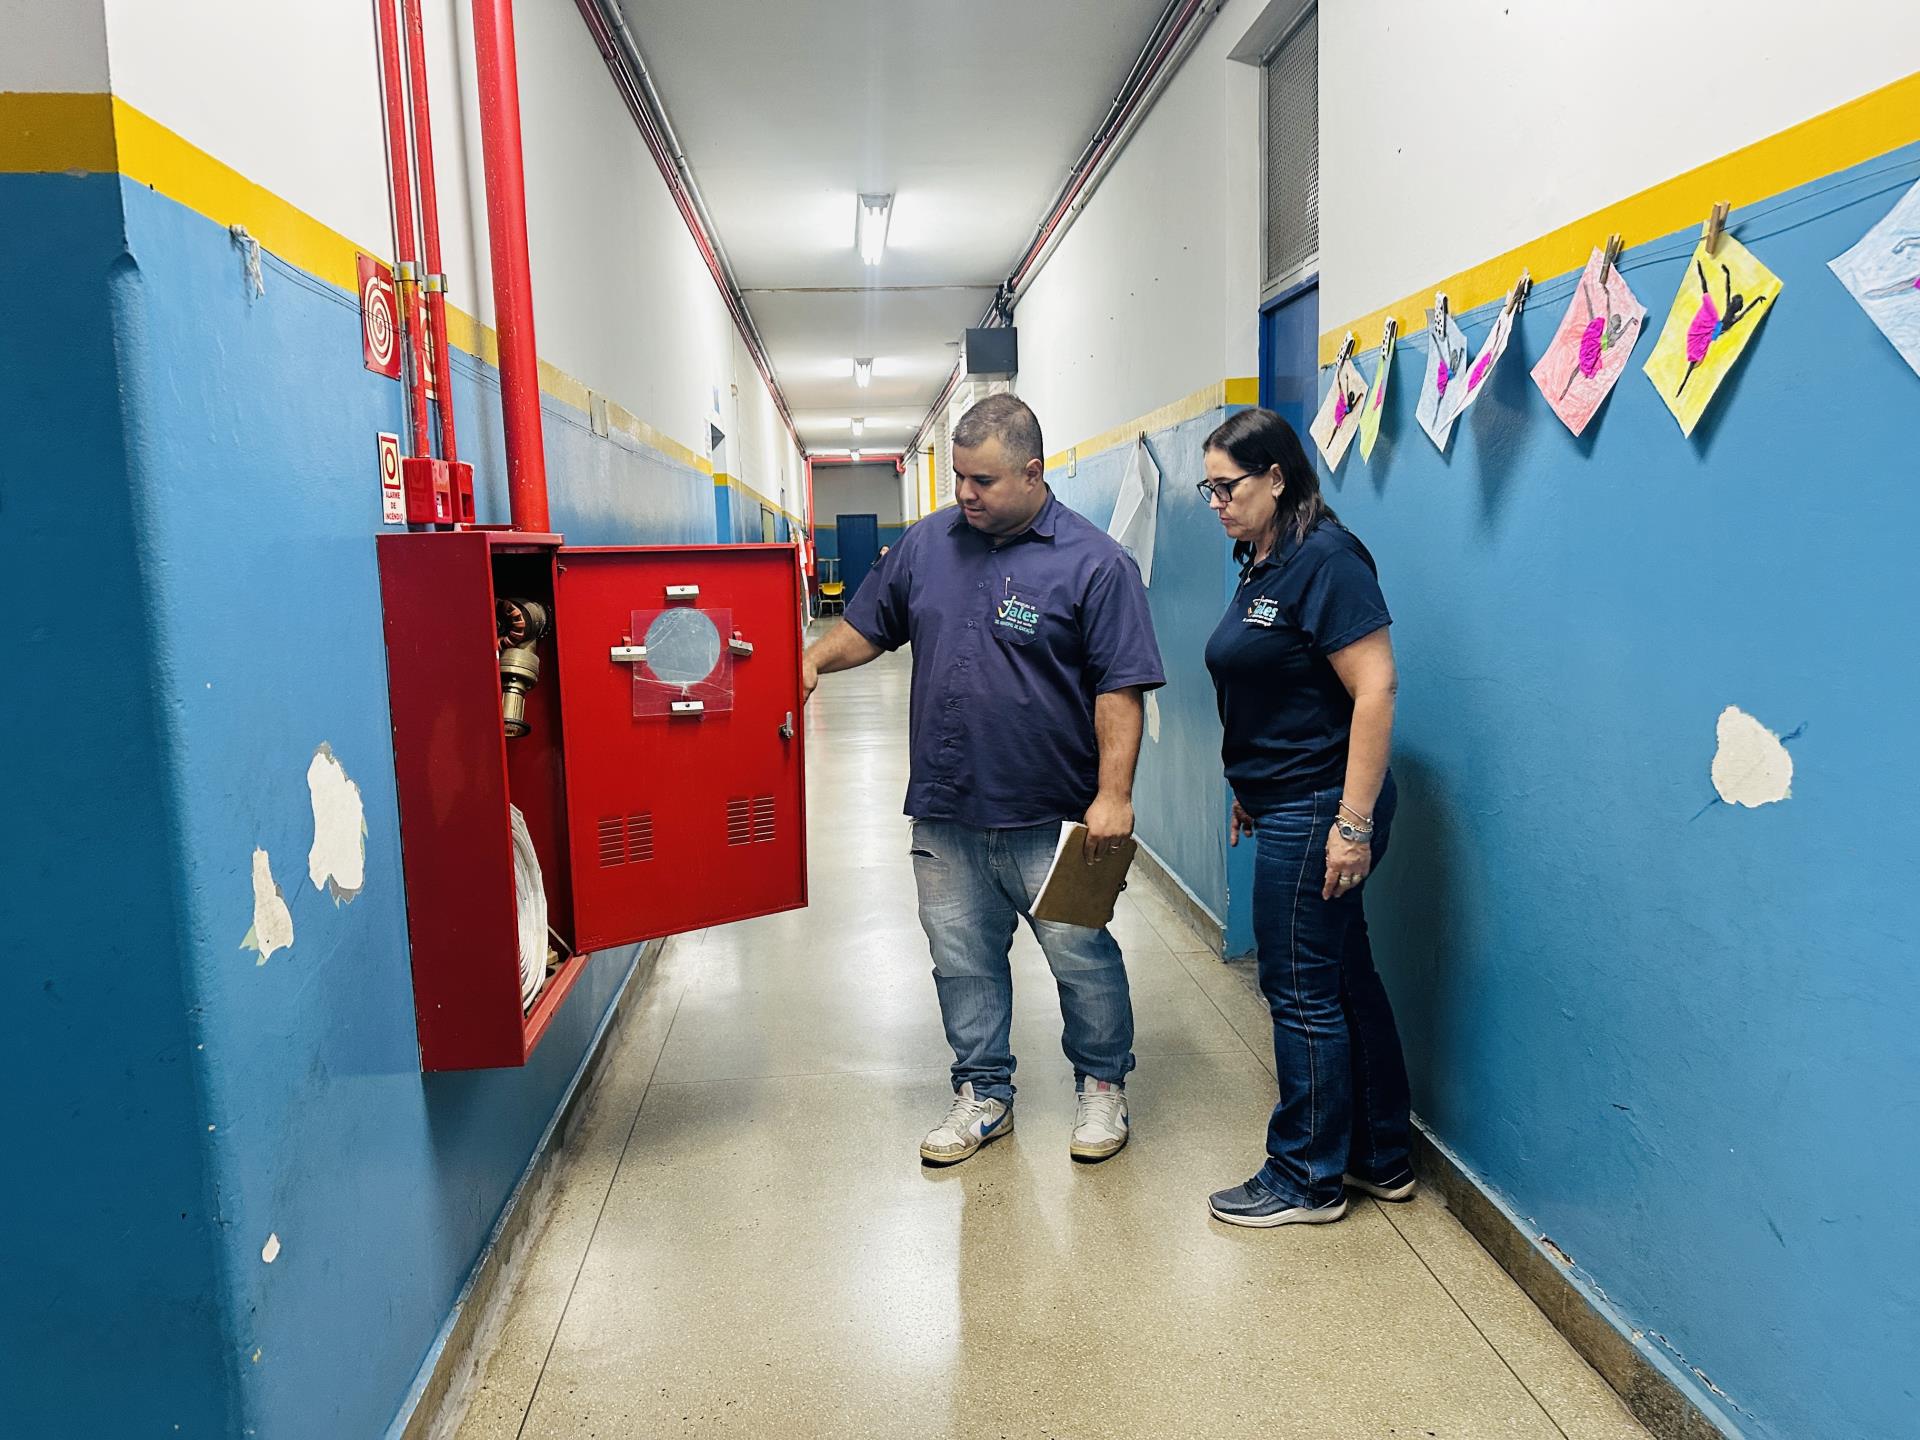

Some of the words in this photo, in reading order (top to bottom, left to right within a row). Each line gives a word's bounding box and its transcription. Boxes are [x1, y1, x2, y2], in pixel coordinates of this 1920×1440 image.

[385, 491, 401, 499] ALARME
[390, 502, 397, 510] DE
[997, 595, 1039, 624] Jales
